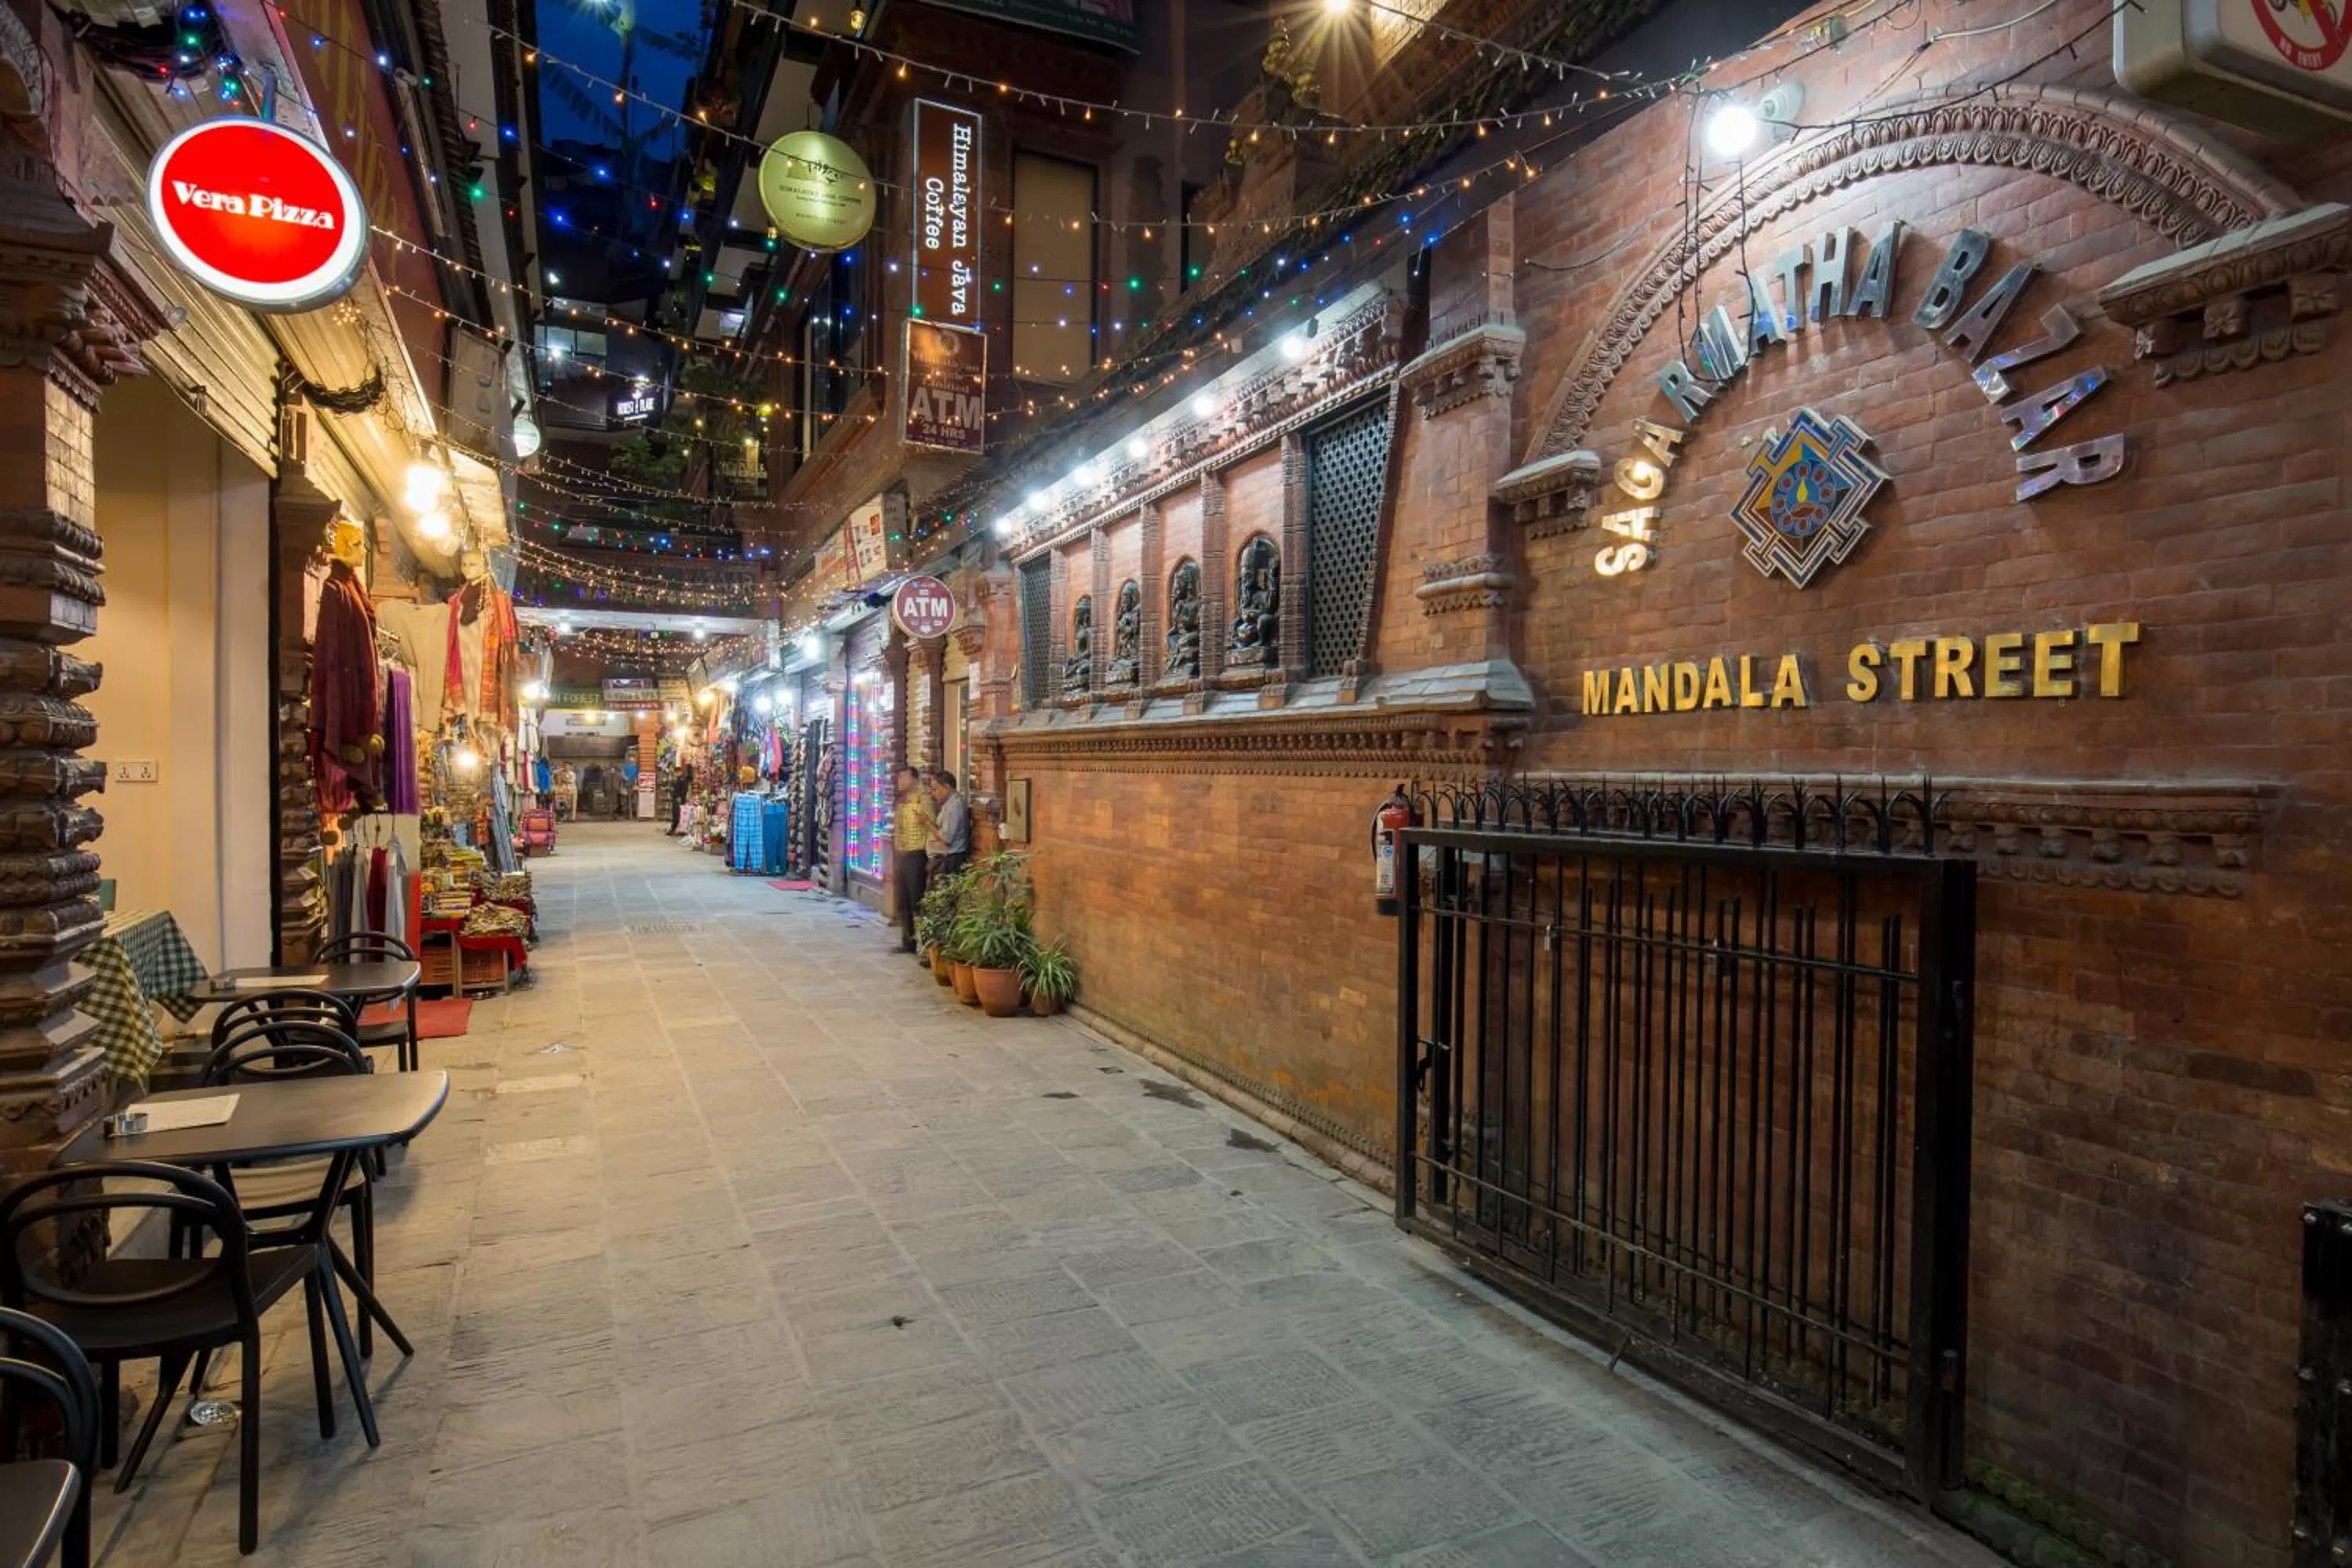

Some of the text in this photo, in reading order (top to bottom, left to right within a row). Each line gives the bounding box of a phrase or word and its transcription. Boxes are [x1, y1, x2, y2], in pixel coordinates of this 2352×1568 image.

[172, 180, 336, 230] Vera Pizza
[925, 176, 944, 250] Coffee
[952, 122, 971, 315] Himalayan Java
[912, 386, 982, 430] ATM
[1594, 219, 2125, 577] SAGARMATHA BAZAR
[923, 423, 966, 440] 24 HRS
[903, 597, 948, 618] ATM
[1581, 622, 2140, 717] MANDALA STREET
